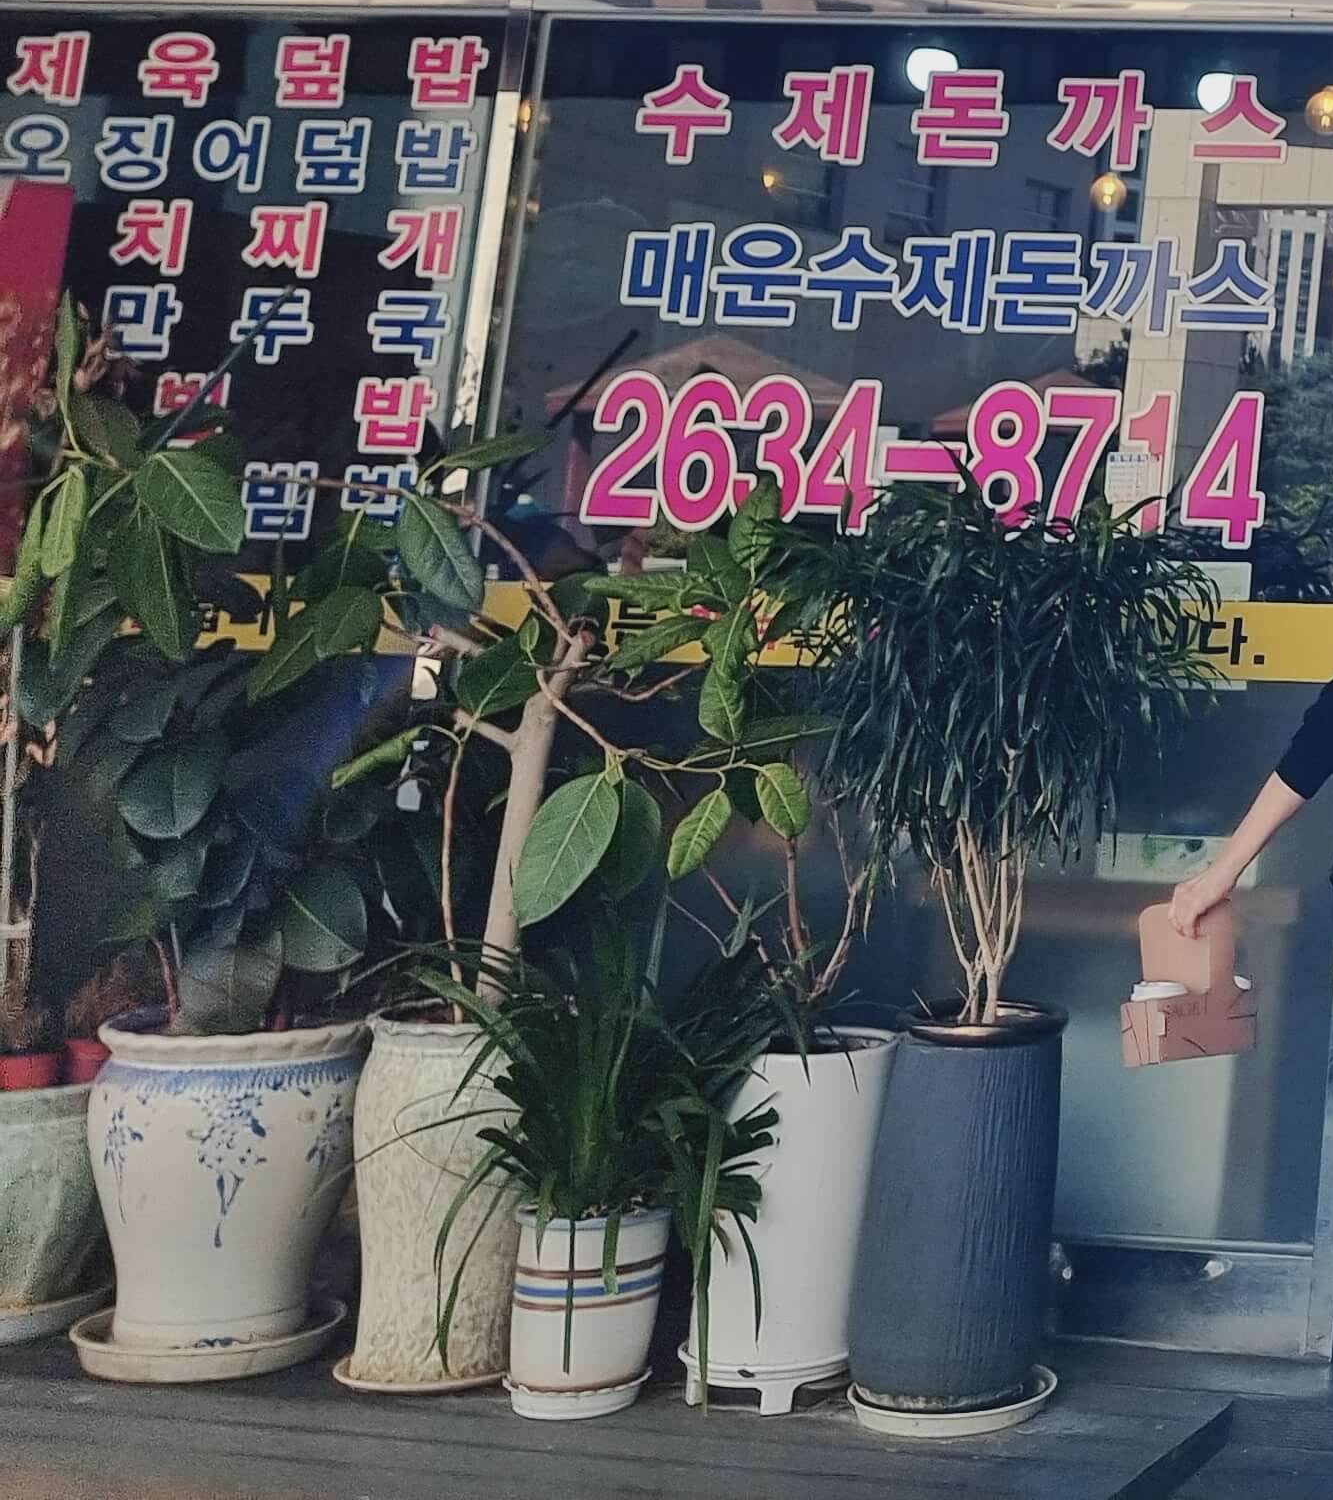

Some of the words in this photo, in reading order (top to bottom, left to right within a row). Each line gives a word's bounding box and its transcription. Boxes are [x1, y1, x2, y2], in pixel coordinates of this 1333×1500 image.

[7, 31, 489, 108] 제육덮밥
[635, 63, 1287, 172] 수제돈까스
[0, 114, 476, 194] 오징어덮밥
[620, 221, 1277, 335] 매운수제돈까스
[578, 368, 1266, 550] 2634-8714
